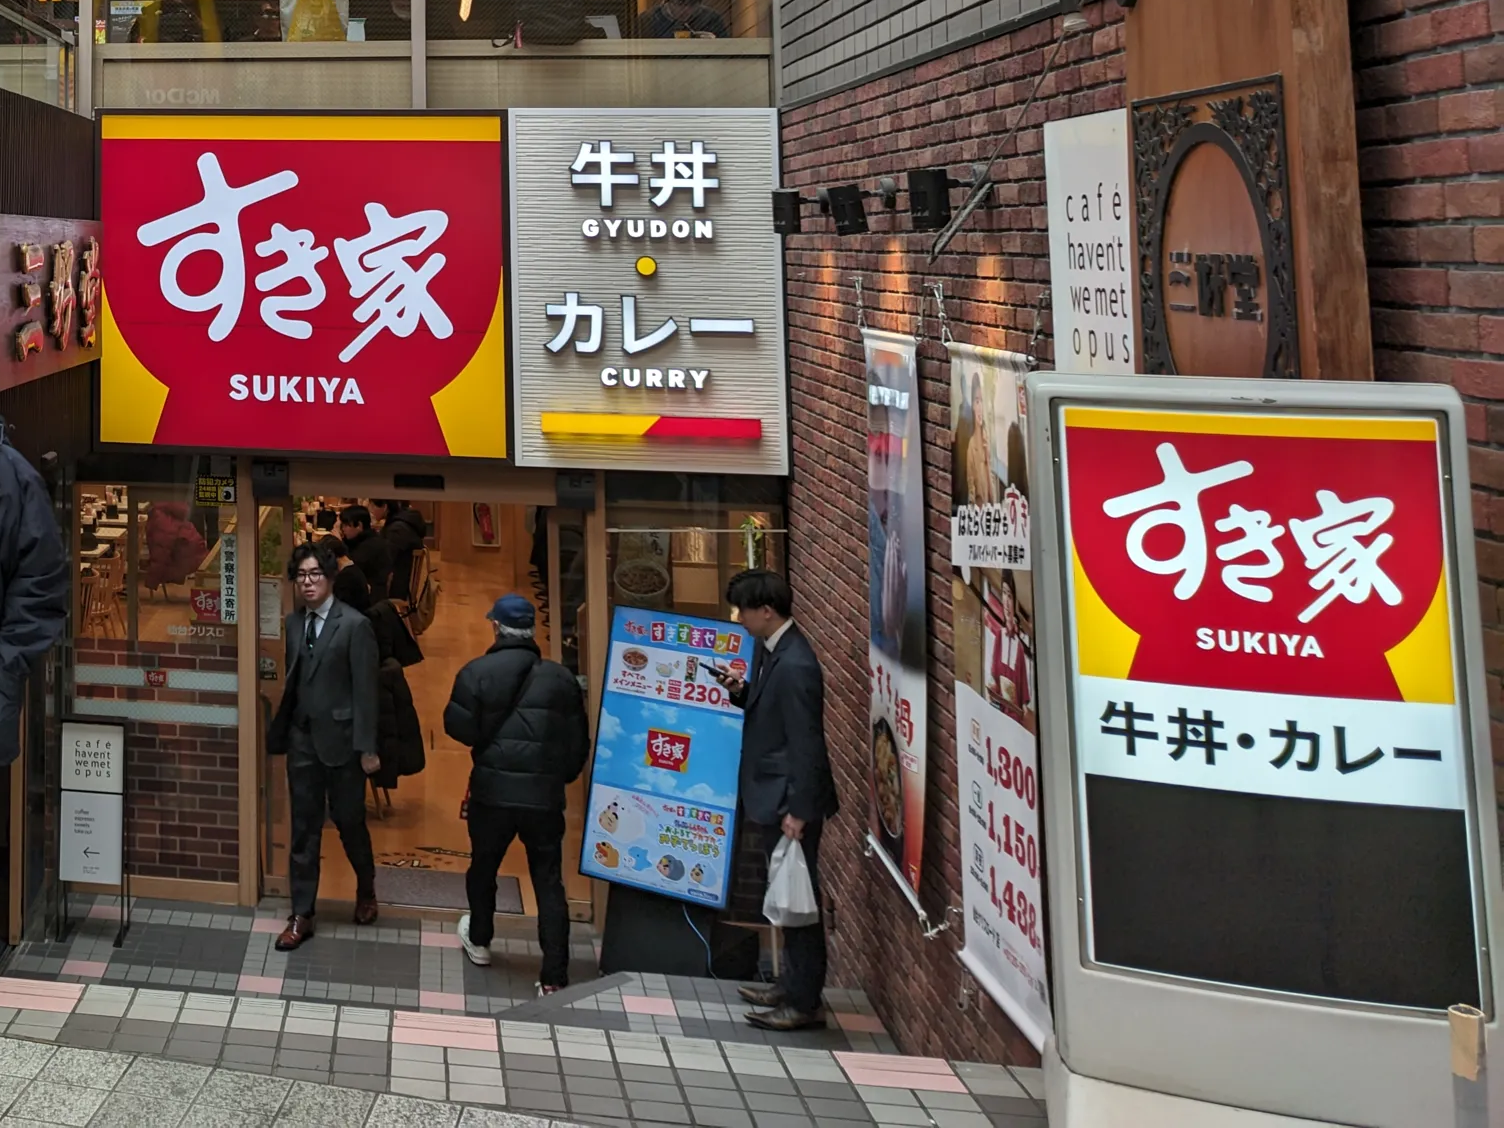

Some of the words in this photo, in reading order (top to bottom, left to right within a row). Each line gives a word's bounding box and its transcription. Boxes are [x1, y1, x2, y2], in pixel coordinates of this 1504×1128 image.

[569, 139, 721, 211] 牛丼
[1066, 182, 1122, 222] café
[581, 218, 714, 240] GYUDON
[136, 151, 454, 363] すき家
[1067, 232, 1125, 272] haven't
[1070, 285, 1091, 315] we
[1094, 283, 1128, 319] met
[543, 291, 756, 356] カレー
[1072, 327, 1130, 368] opus
[228, 373, 365, 405] SUKIYA
[599, 366, 711, 391] CURRY
[1102, 441, 1403, 624] すき家
[223, 550, 236, 621] 警察官立寄所
[1196, 626, 1325, 660] SUKIYA
[75, 739, 112, 750] café
[75, 749, 111, 760] haven't
[651, 733, 685, 761] すき家
[1099, 699, 1443, 775] 牛丼・カレー
[74, 768, 111, 778] opus
[75, 759, 89, 768] we
[91, 759, 111, 769] met
[986, 736, 1036, 810] 1,300
[988, 800, 1040, 880] 1,150
